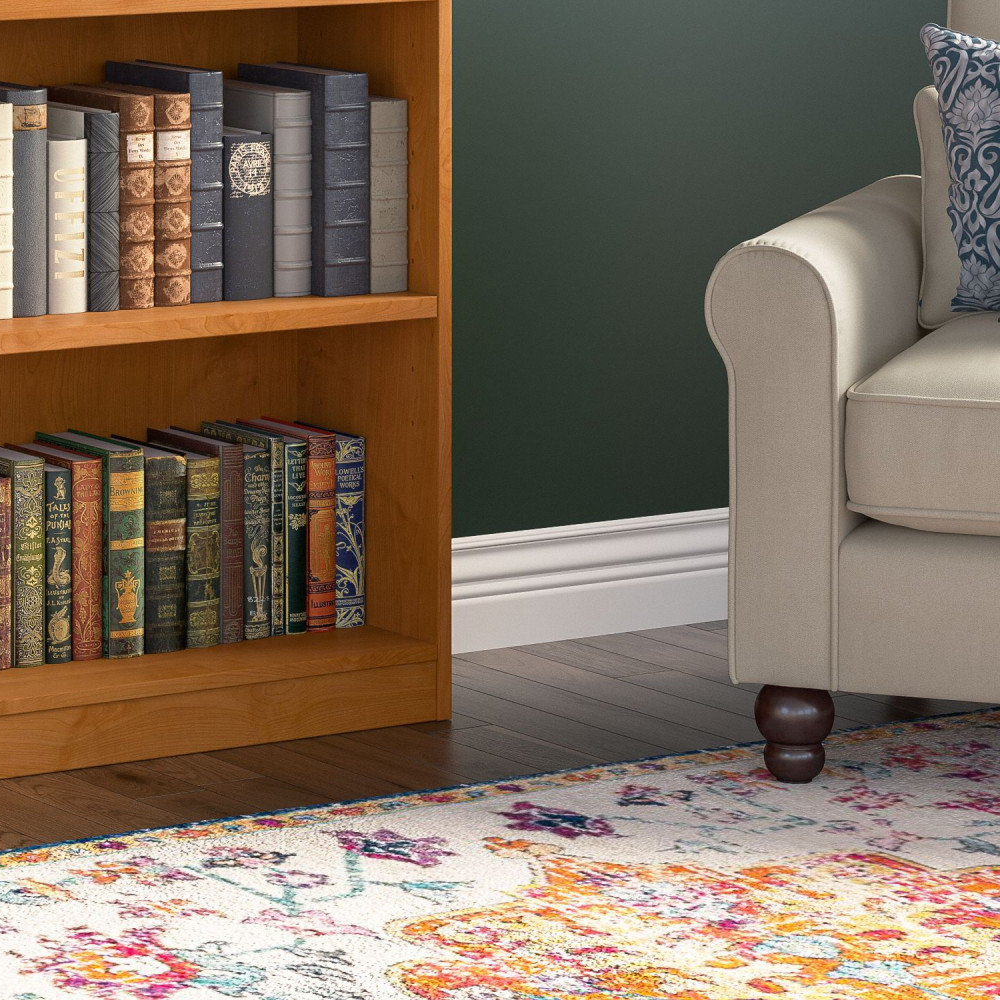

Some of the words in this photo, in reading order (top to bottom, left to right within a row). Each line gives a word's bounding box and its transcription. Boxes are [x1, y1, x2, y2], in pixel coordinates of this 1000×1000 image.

[53, 166, 85, 280] UFFIZI
[337, 474, 362, 482] POETICAL
[339, 482, 360, 490] WORKS
[110, 487, 144, 497] BROWNIN
[46, 501, 71, 513] TALES
